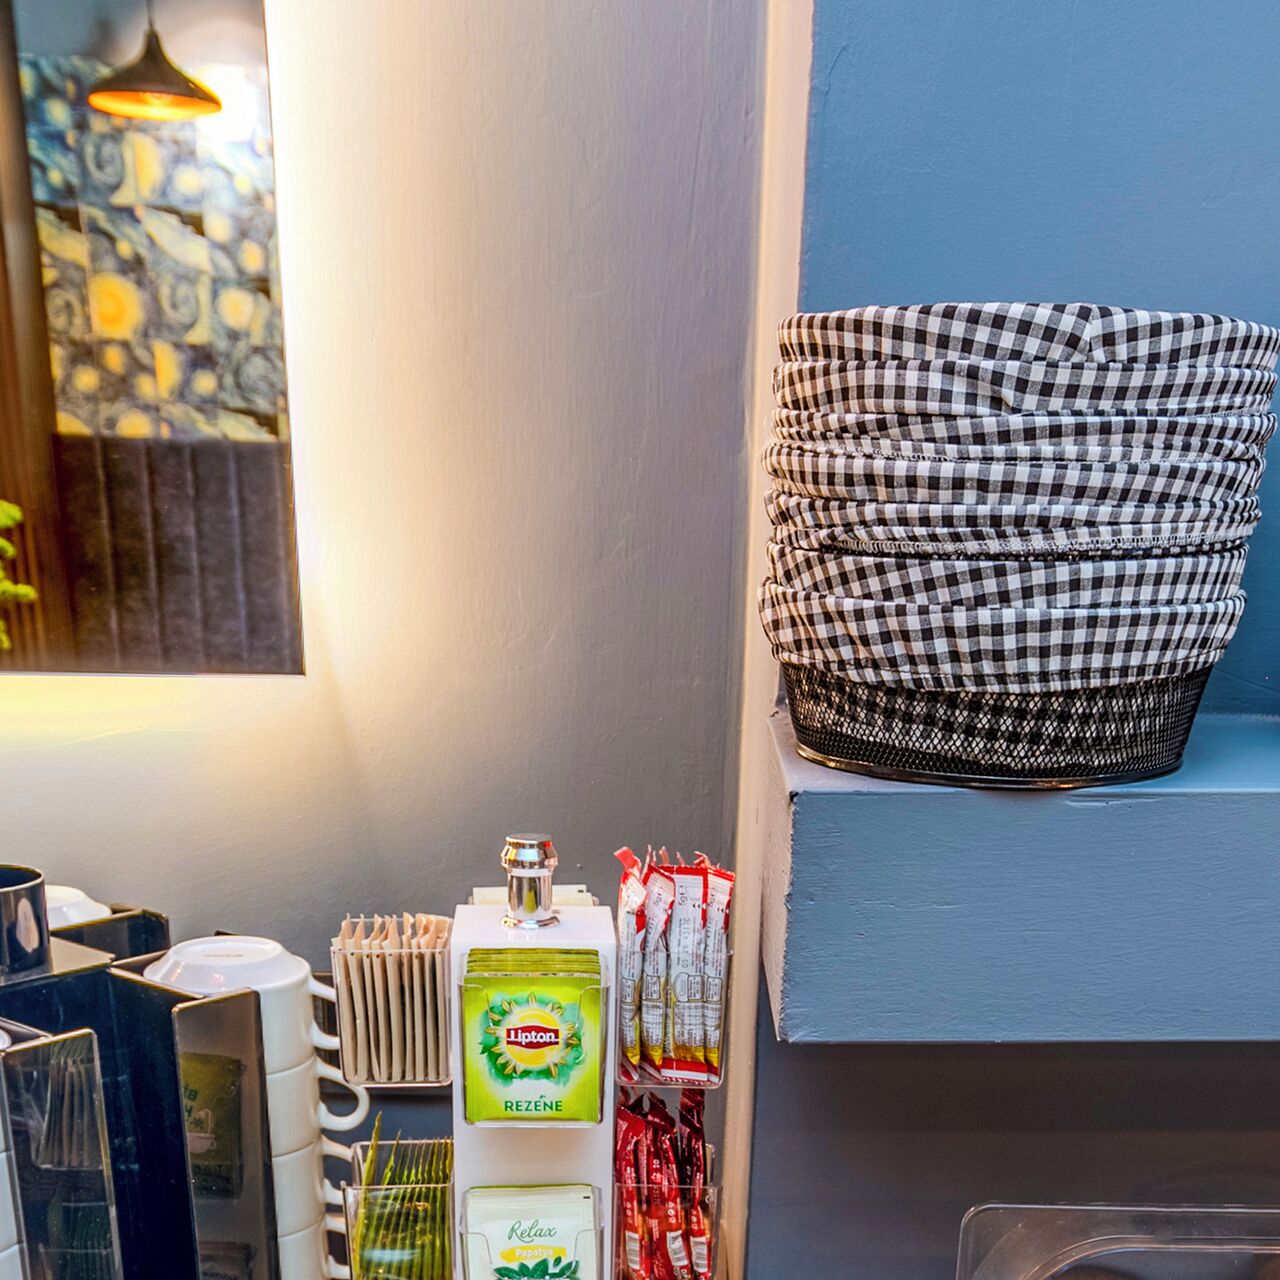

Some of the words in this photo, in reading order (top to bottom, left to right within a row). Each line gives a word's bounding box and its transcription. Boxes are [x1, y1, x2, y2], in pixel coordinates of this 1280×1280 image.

[509, 1029, 557, 1045] Lipton
[504, 1100, 563, 1112] REZENE
[507, 1220, 557, 1243] Relax
[515, 1247, 553, 1259] Papatya
